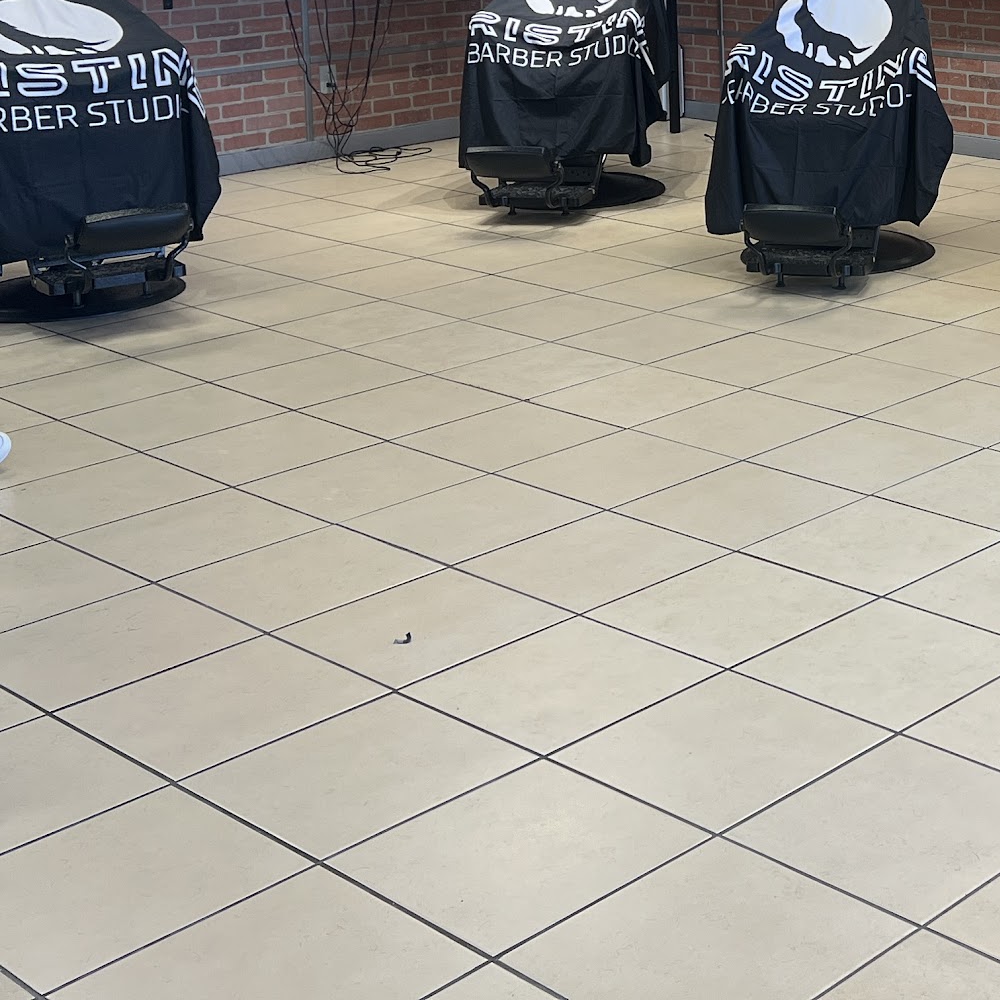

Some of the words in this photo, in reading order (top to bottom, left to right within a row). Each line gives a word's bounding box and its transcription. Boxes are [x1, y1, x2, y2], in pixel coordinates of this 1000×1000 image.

[467, 43, 563, 68] BARBER
[568, 35, 641, 66] STUD
[87, 93, 182, 128] STUDI
[813, 83, 904, 118] STUO
